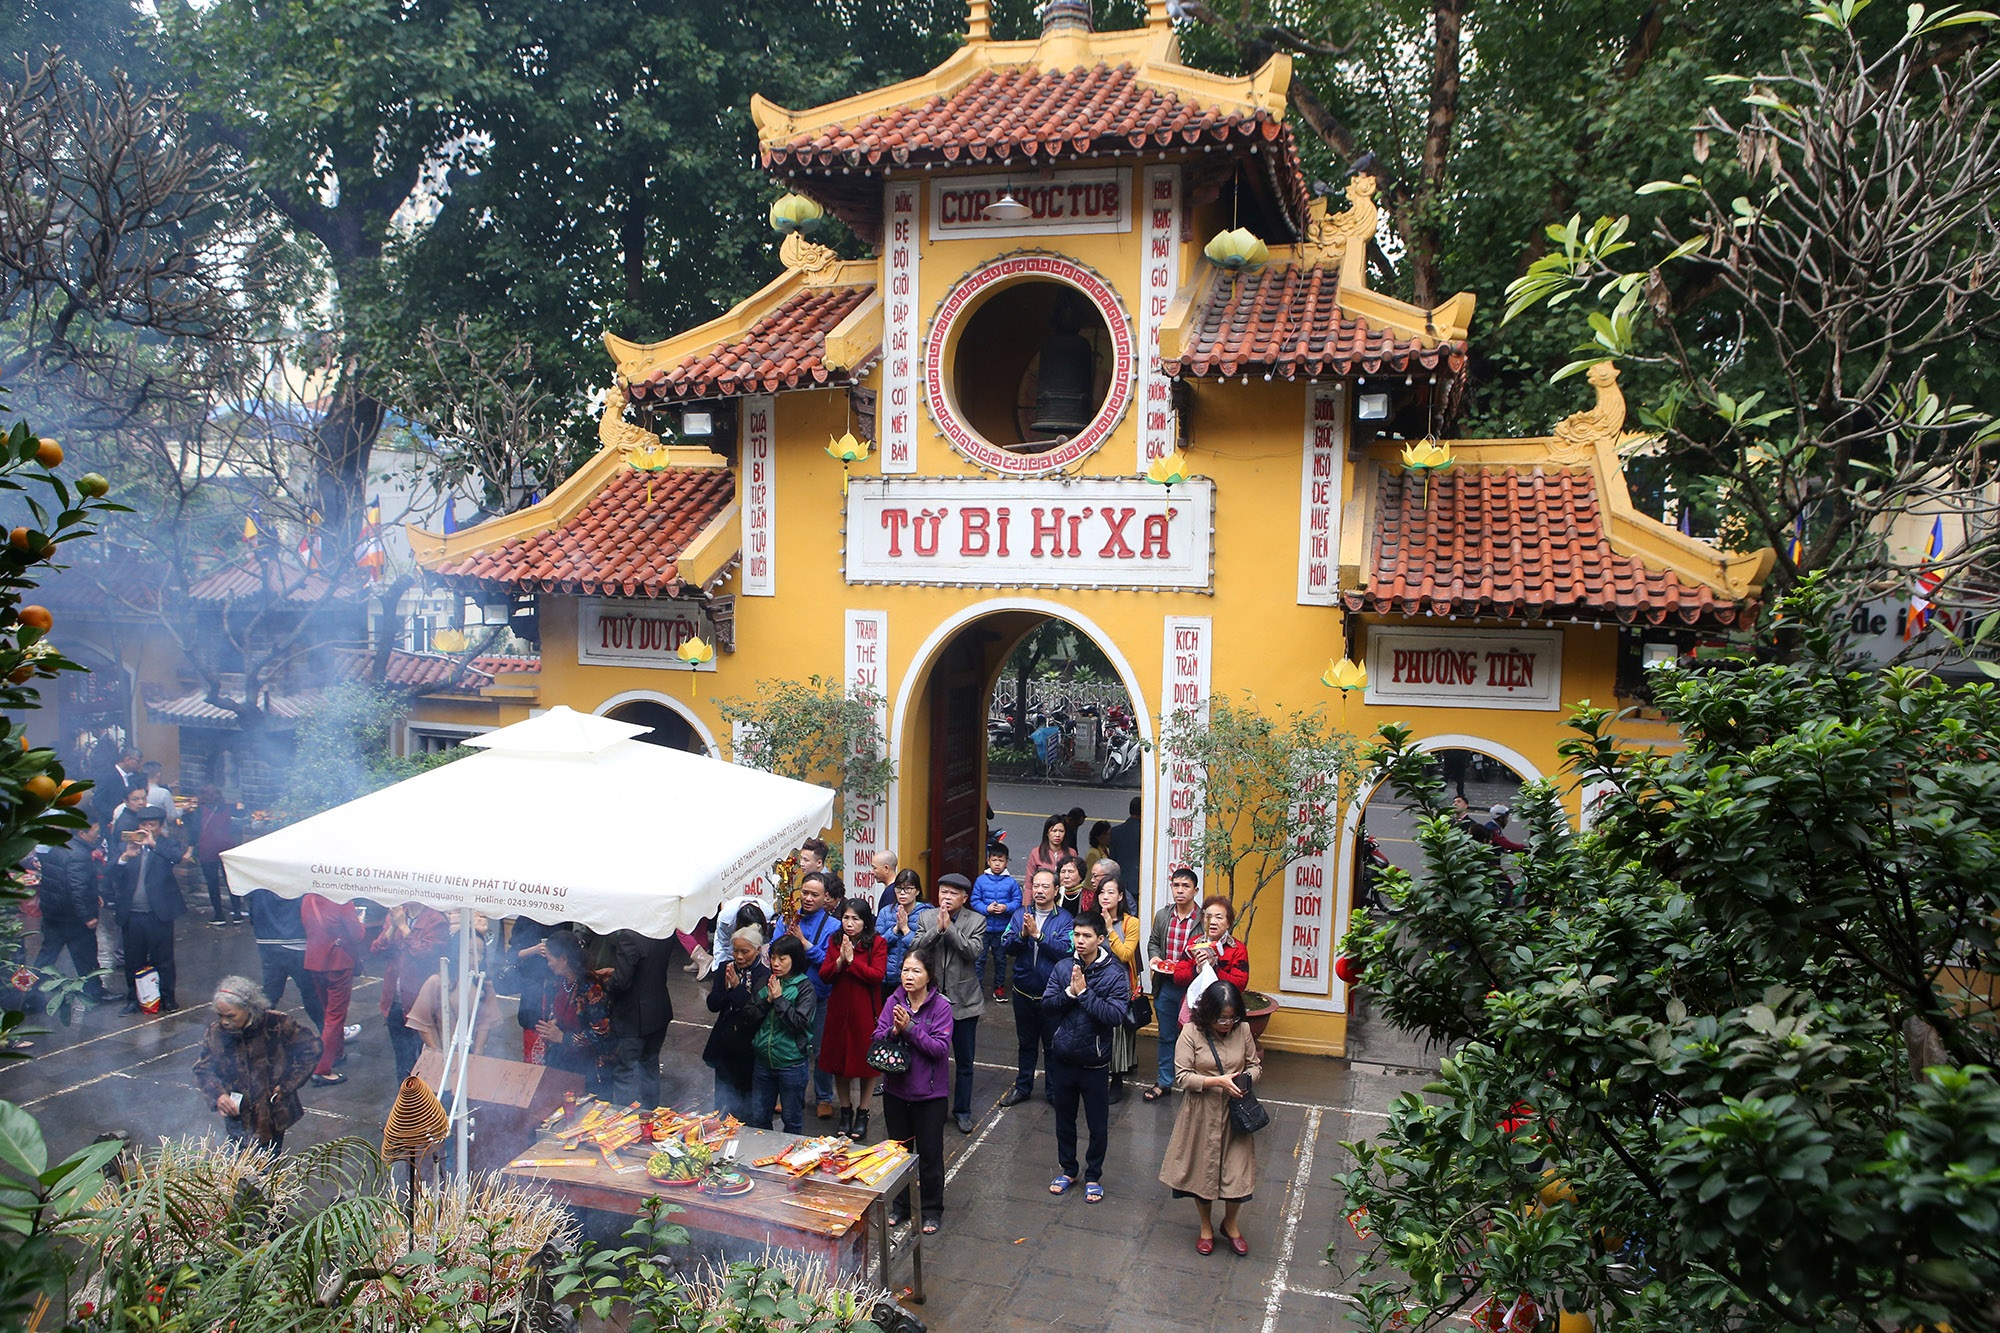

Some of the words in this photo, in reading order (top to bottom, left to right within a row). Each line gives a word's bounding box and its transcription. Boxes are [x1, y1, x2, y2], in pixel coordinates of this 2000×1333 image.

[995, 185, 1064, 221] HÚC
[1067, 182, 1119, 217] TUỆ
[895, 219, 909, 243] BỆ
[893, 246, 909, 270] ĐỘI
[1152, 264, 1168, 287] GIÓ
[893, 304, 909, 325] ĐẠP
[892, 328, 908, 350] ĐẤT
[892, 411, 908, 433] NIẾT
[1315, 422, 1333, 448] GIÁC
[1146, 437, 1165, 459] GIÁC
[753, 462, 764, 482] BI
[1313, 455, 1331, 480] NGỘ
[751, 483, 766, 505] TIẾP
[881, 507, 949, 558] TỪ
[959, 507, 1011, 557] BI
[1030, 507, 1094, 558] HỈ
[1099, 507, 1178, 559] XẢ
[1311, 531, 1328, 558] TIẾN
[751, 556, 766, 577] DUYÊN
[856, 642, 877, 663] THẾ
[1176, 653, 1198, 676] TRẦN
[1485, 648, 1536, 691] TIỆN
[1174, 680, 1198, 704] DUYÊN
[856, 804, 875, 822] SI
[311, 863, 331, 875] CÂU
[334, 866, 354, 879] LẠC
[356, 866, 371, 880] BỘ
[373, 868, 409, 881] THANH
[412, 870, 442, 884] THIẾU
[444, 874, 469, 888] NIÊN
[472, 878, 500, 891] PHẬT
[502, 879, 518, 891] TỬ
[519, 882, 550, 896] QUÁN
[552, 886, 568, 898] SỨ
[1296, 864, 1322, 888] CHÀO
[475, 895, 506, 906] Hotline:
[507, 898, 565, 912] 0243.9970.982
[1295, 892, 1322, 917] ĐÓN
[1293, 925, 1320, 951] PHẬT
[1291, 953, 1319, 978] ĐÀI
